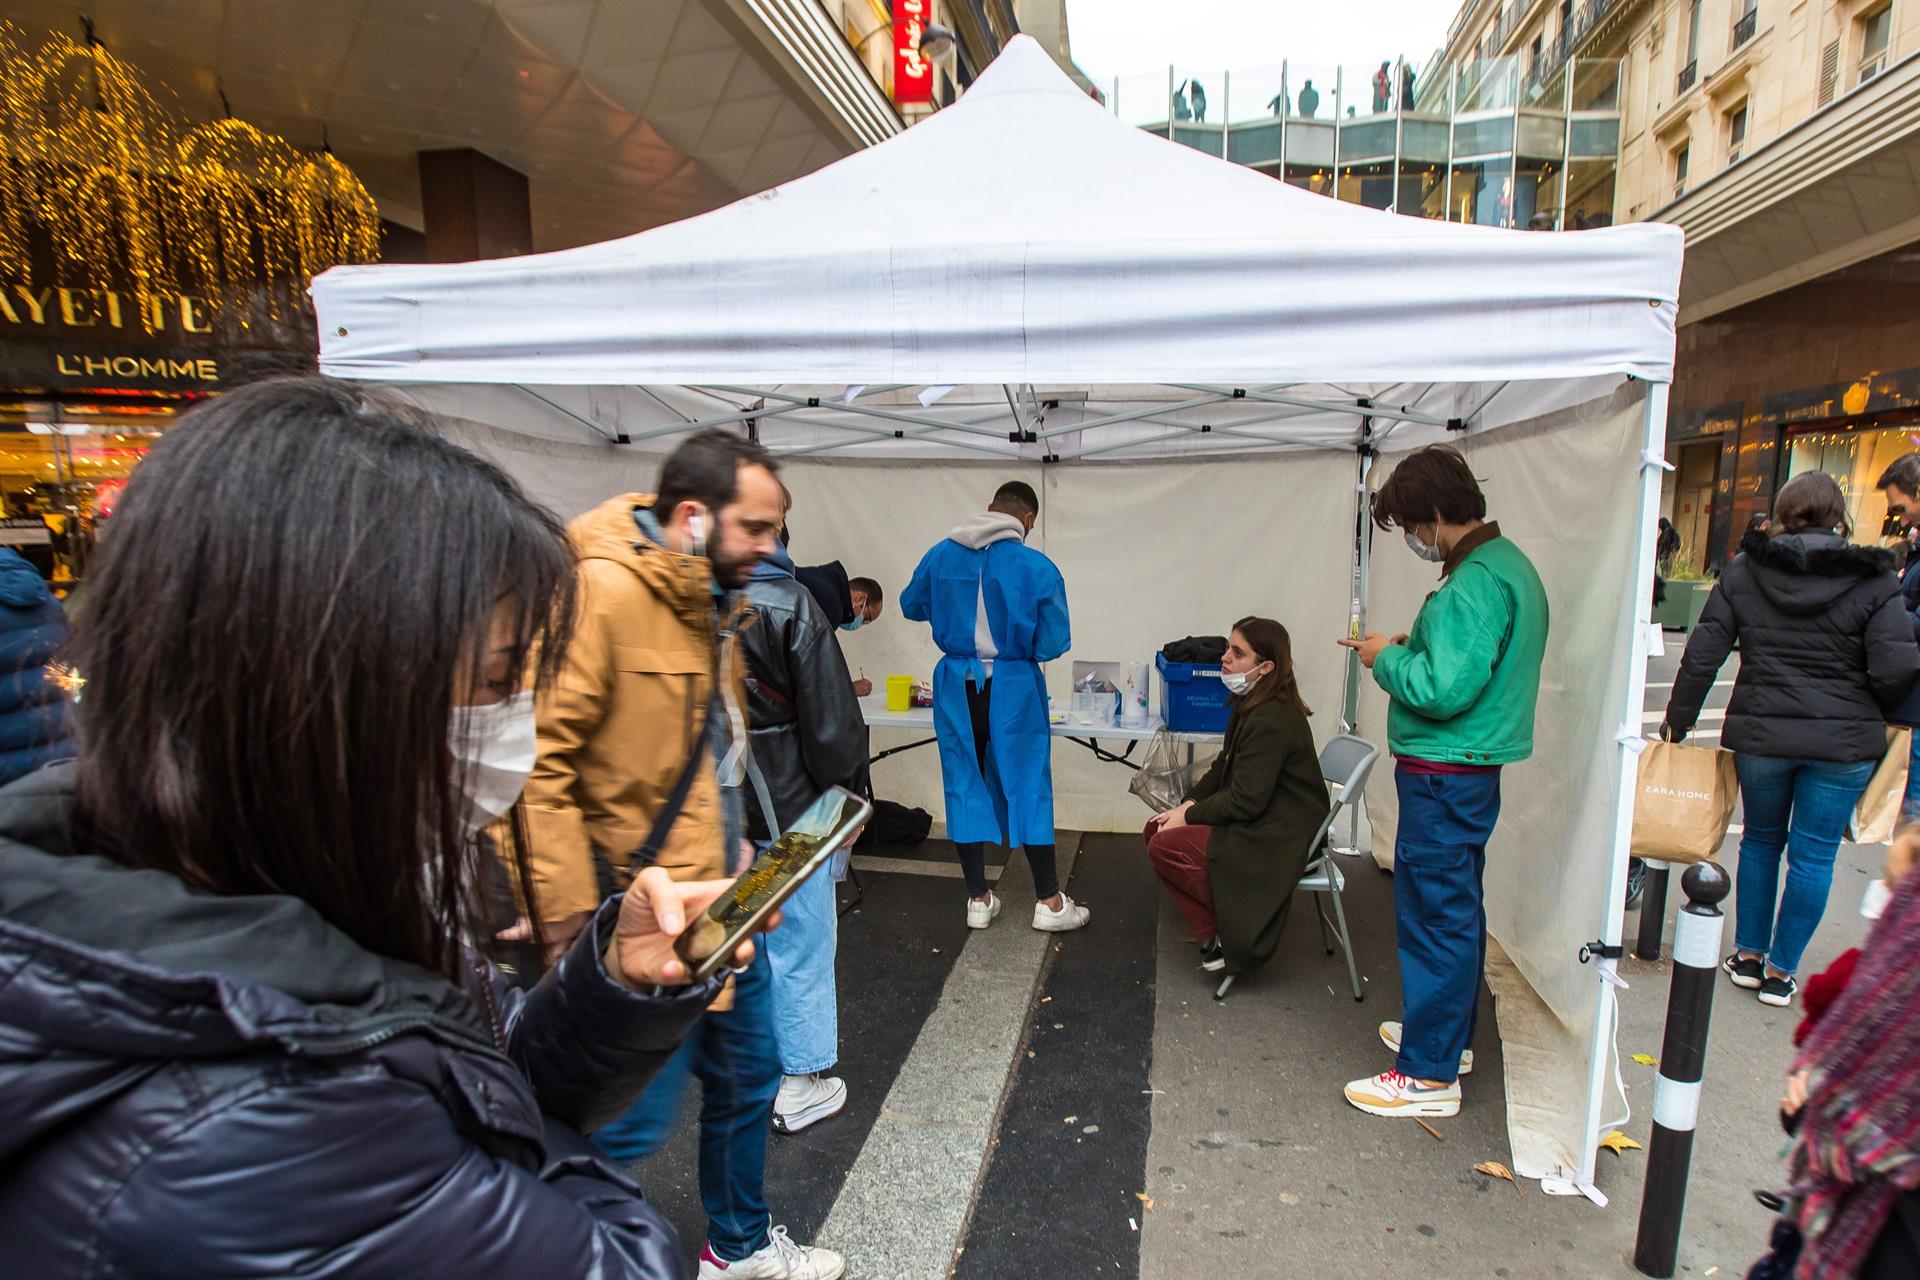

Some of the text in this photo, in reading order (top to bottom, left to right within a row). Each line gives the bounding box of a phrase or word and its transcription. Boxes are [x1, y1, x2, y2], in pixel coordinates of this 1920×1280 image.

[56, 353, 219, 381] L'HOMME
[1645, 785, 1711, 800] ZARA HOME
